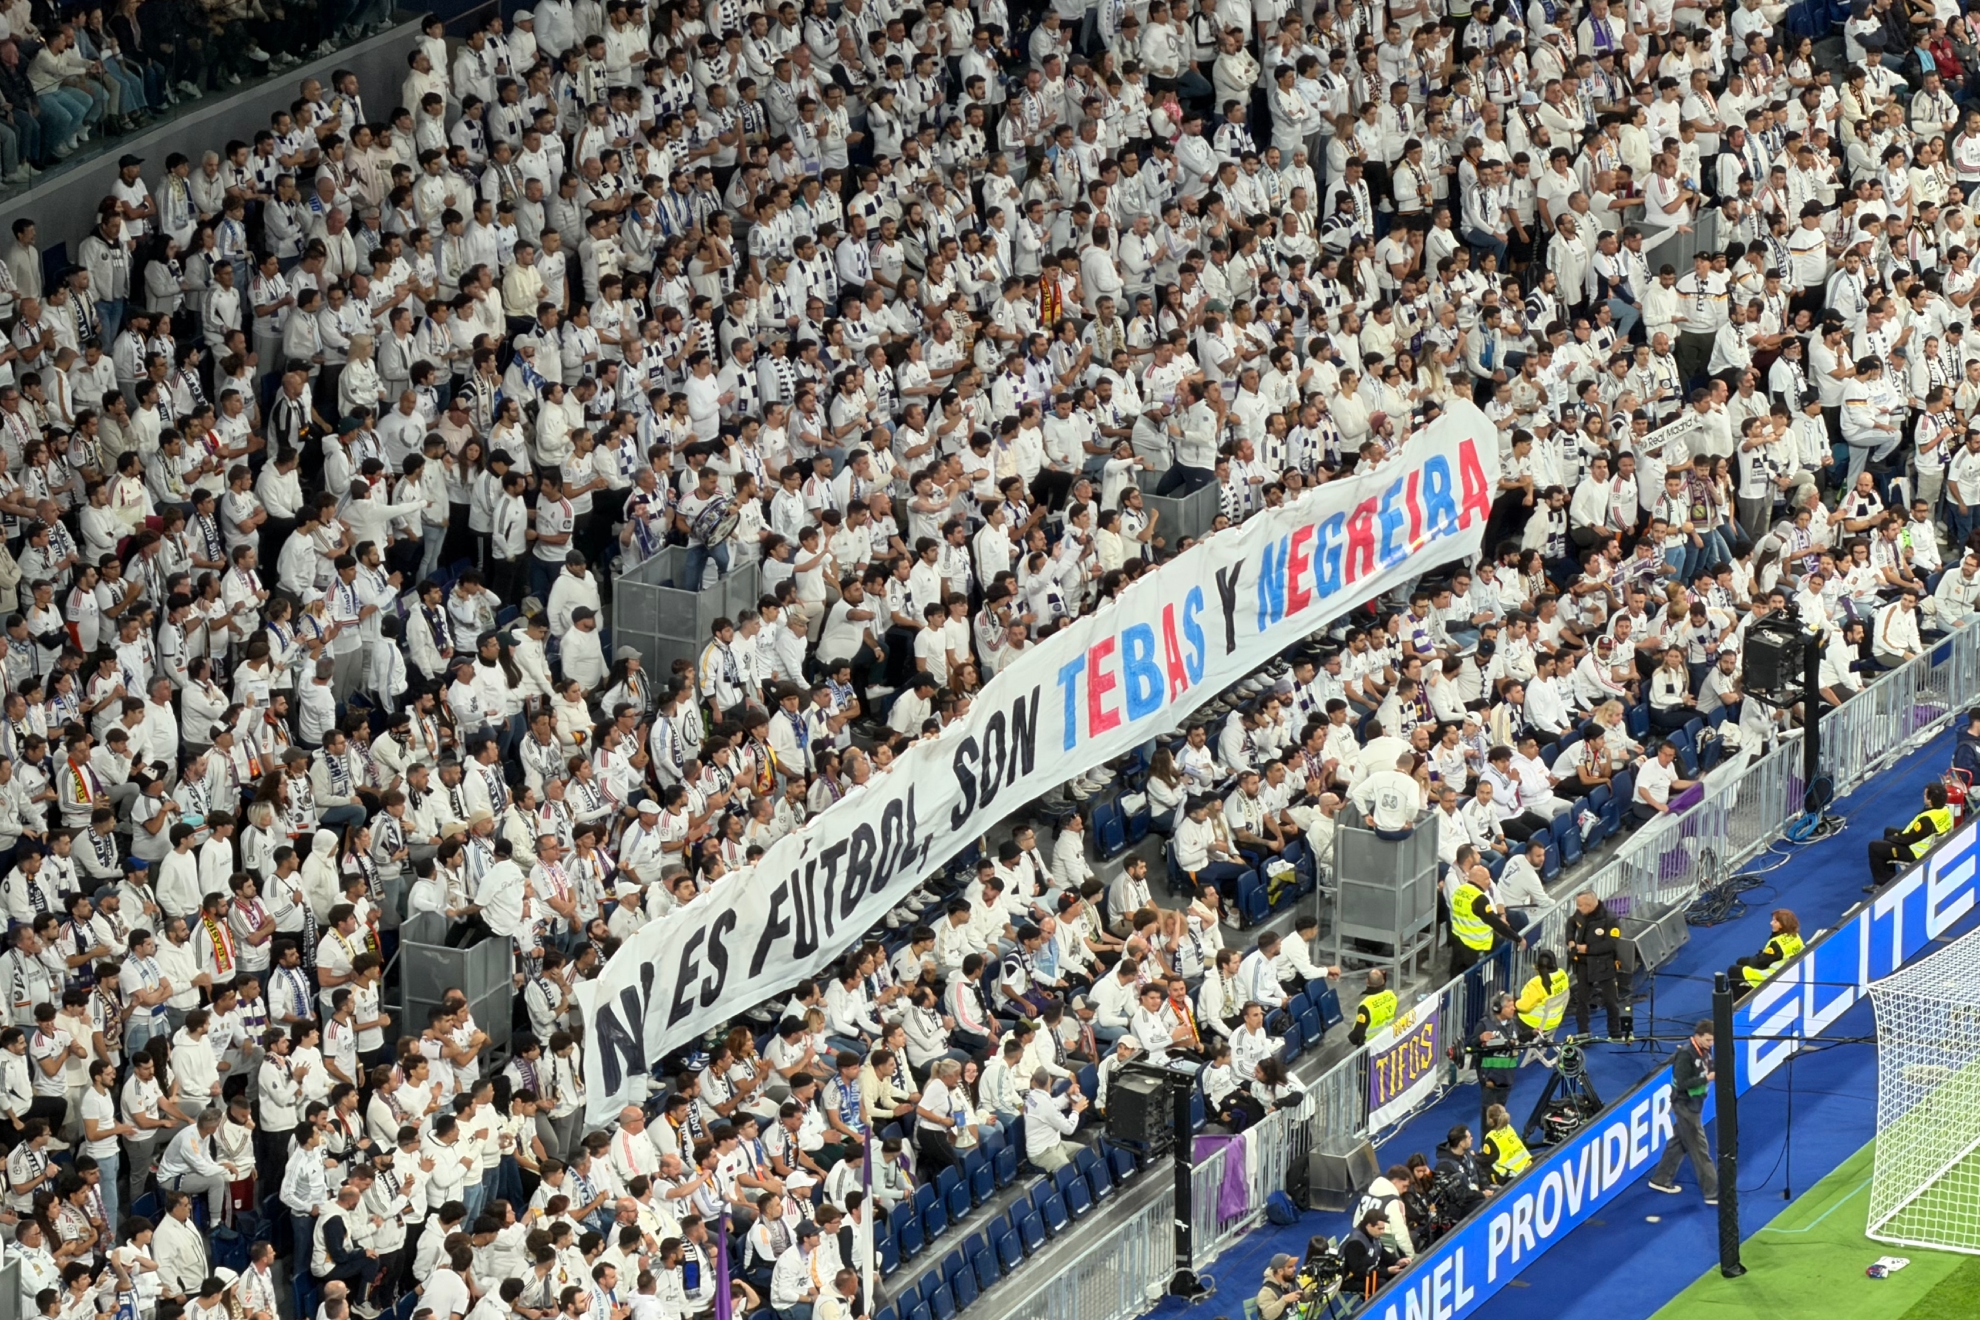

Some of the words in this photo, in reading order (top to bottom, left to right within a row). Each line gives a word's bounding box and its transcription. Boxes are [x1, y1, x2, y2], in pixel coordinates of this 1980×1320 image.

[1648, 431, 1665, 447] Real
[1667, 416, 1693, 438] Madrid
[666, 907, 737, 1031] ES
[748, 782, 934, 980] FÚTBOL,
[951, 684, 1041, 831] SON
[1057, 585, 1205, 752] TEBAS
[1215, 557, 1246, 656] Y
[1257, 438, 1491, 632] NEGREIRA
[1748, 822, 1977, 1086] ELITE
[1375, 1023, 1433, 1103] TIFOS
[1488, 1083, 1674, 1284] PROVIDER
